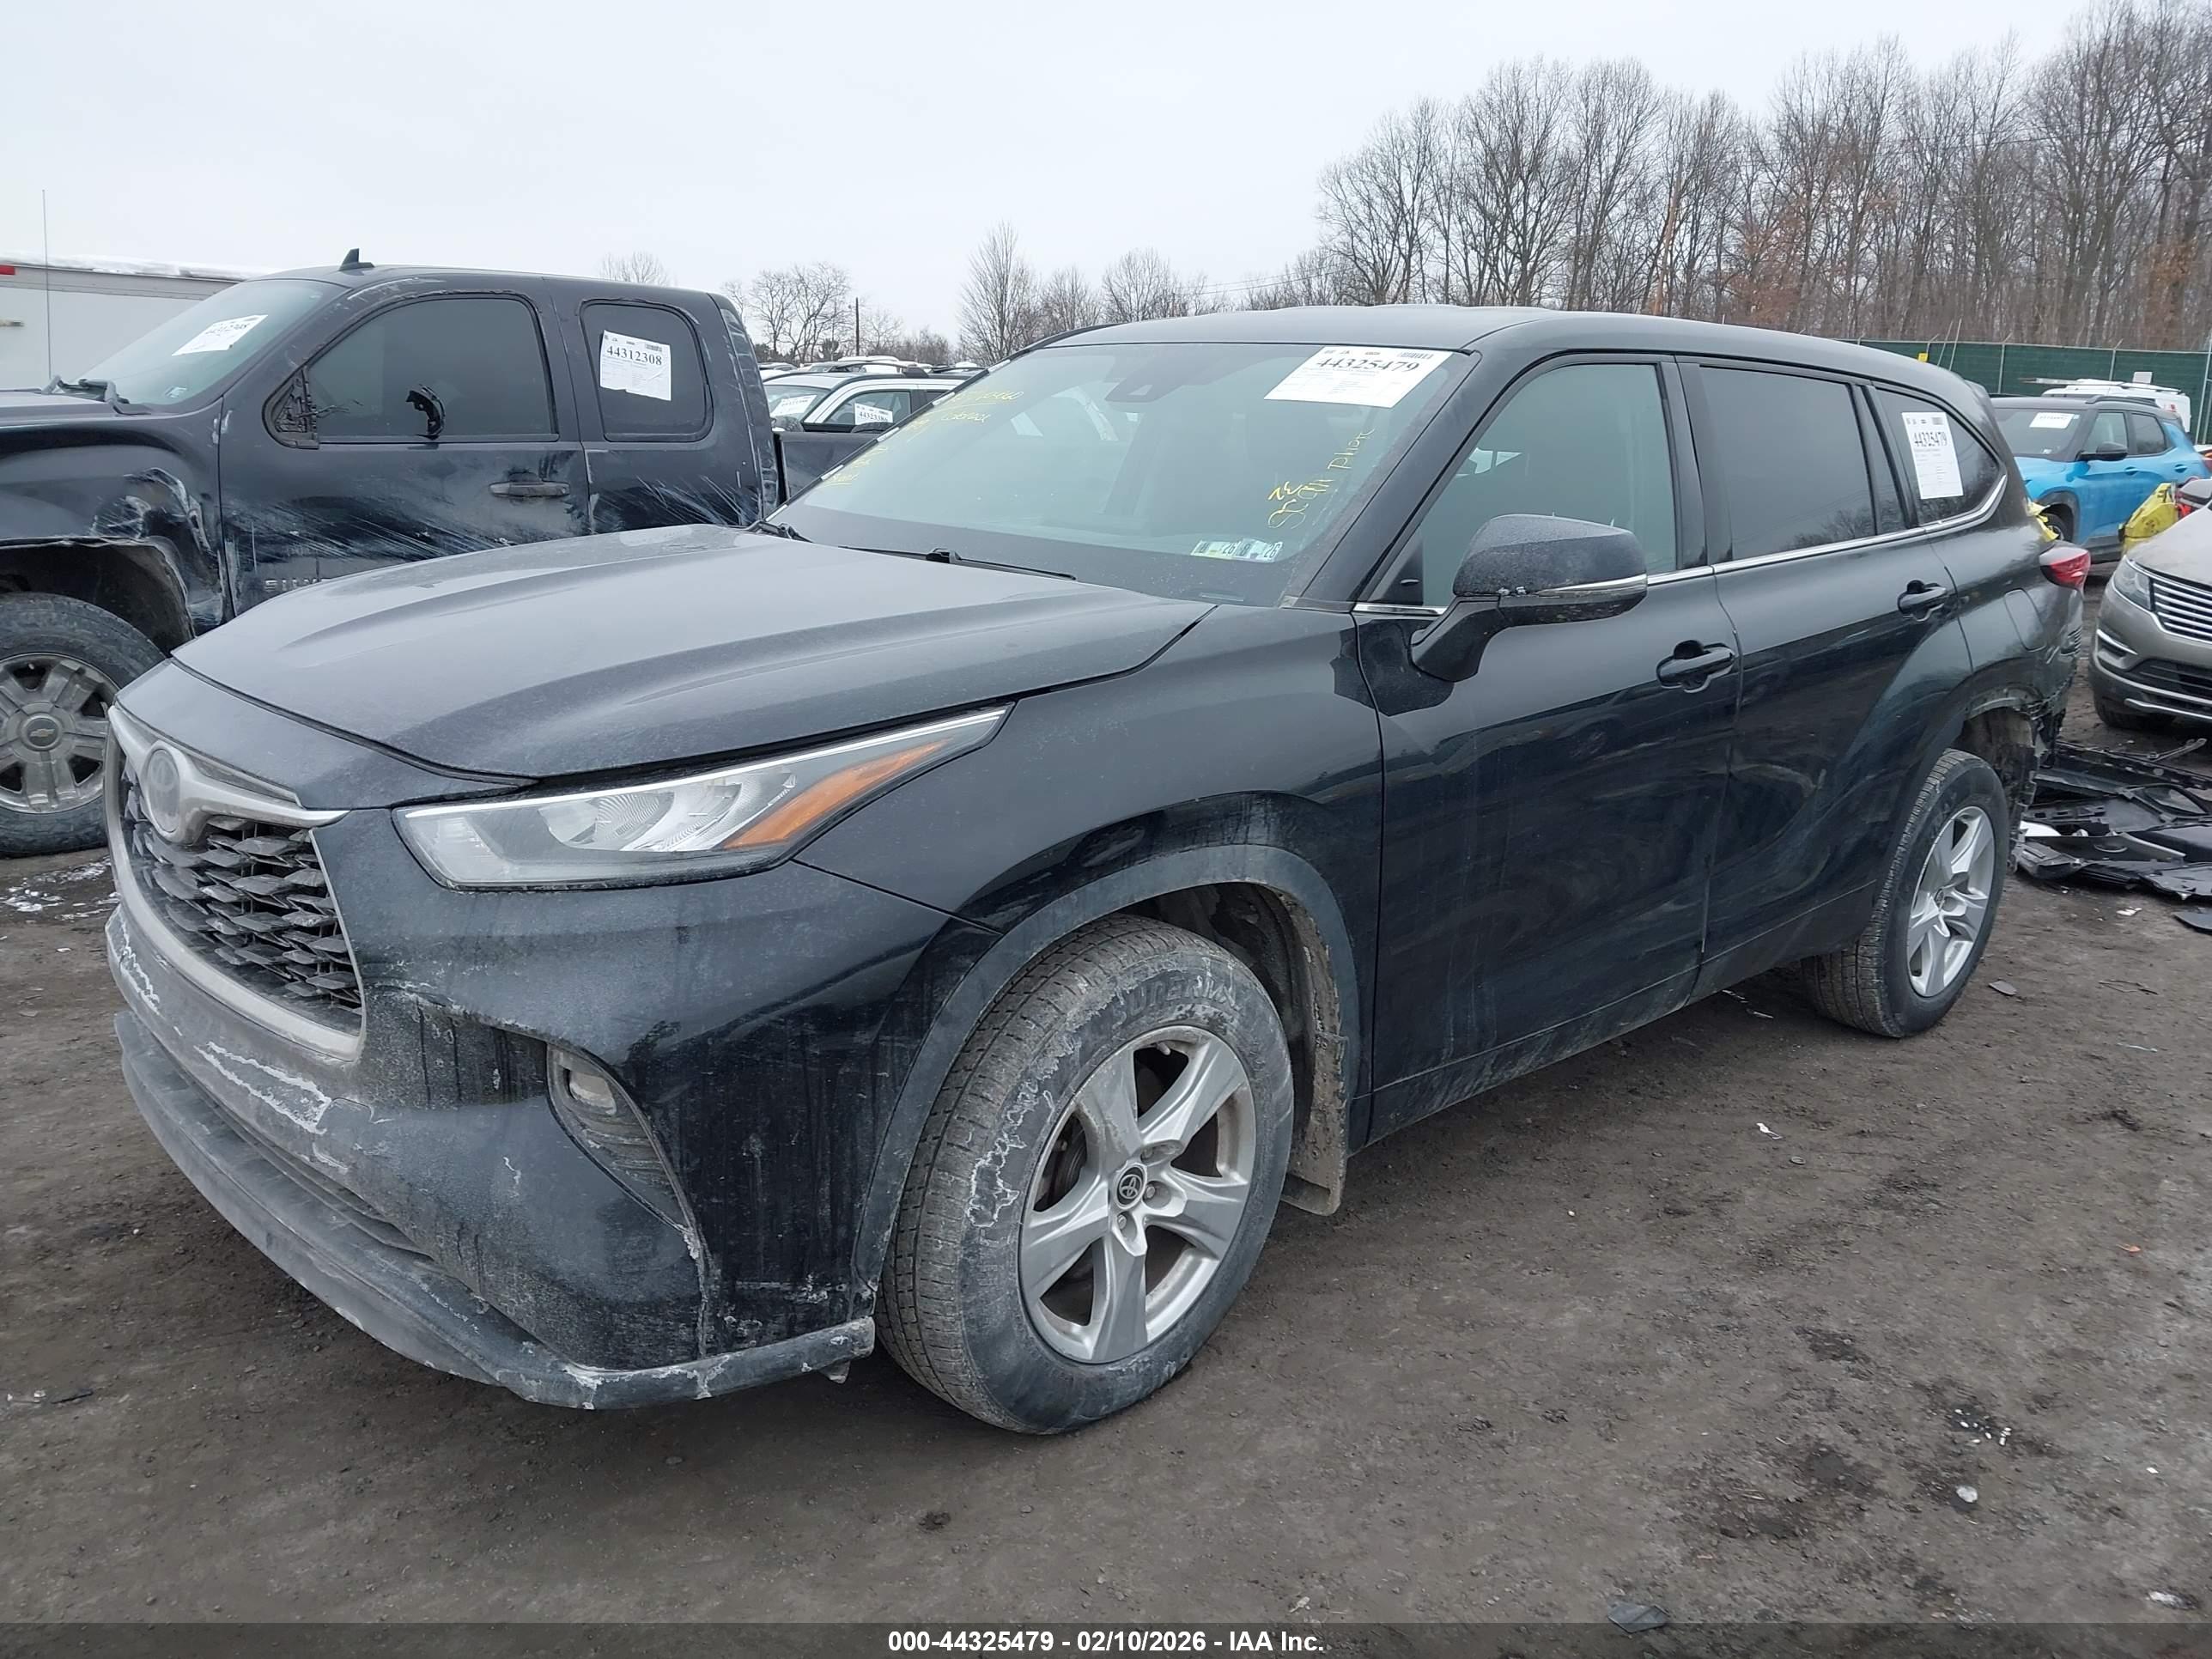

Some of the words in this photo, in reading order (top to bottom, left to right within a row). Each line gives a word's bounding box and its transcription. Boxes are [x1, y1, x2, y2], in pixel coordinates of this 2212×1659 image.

[606, 345, 662, 366] 44312308
[1316, 357, 1420, 372] 44325479
[1914, 432, 1948, 447] 44325479
[1263, 542, 1282, 558] 26
